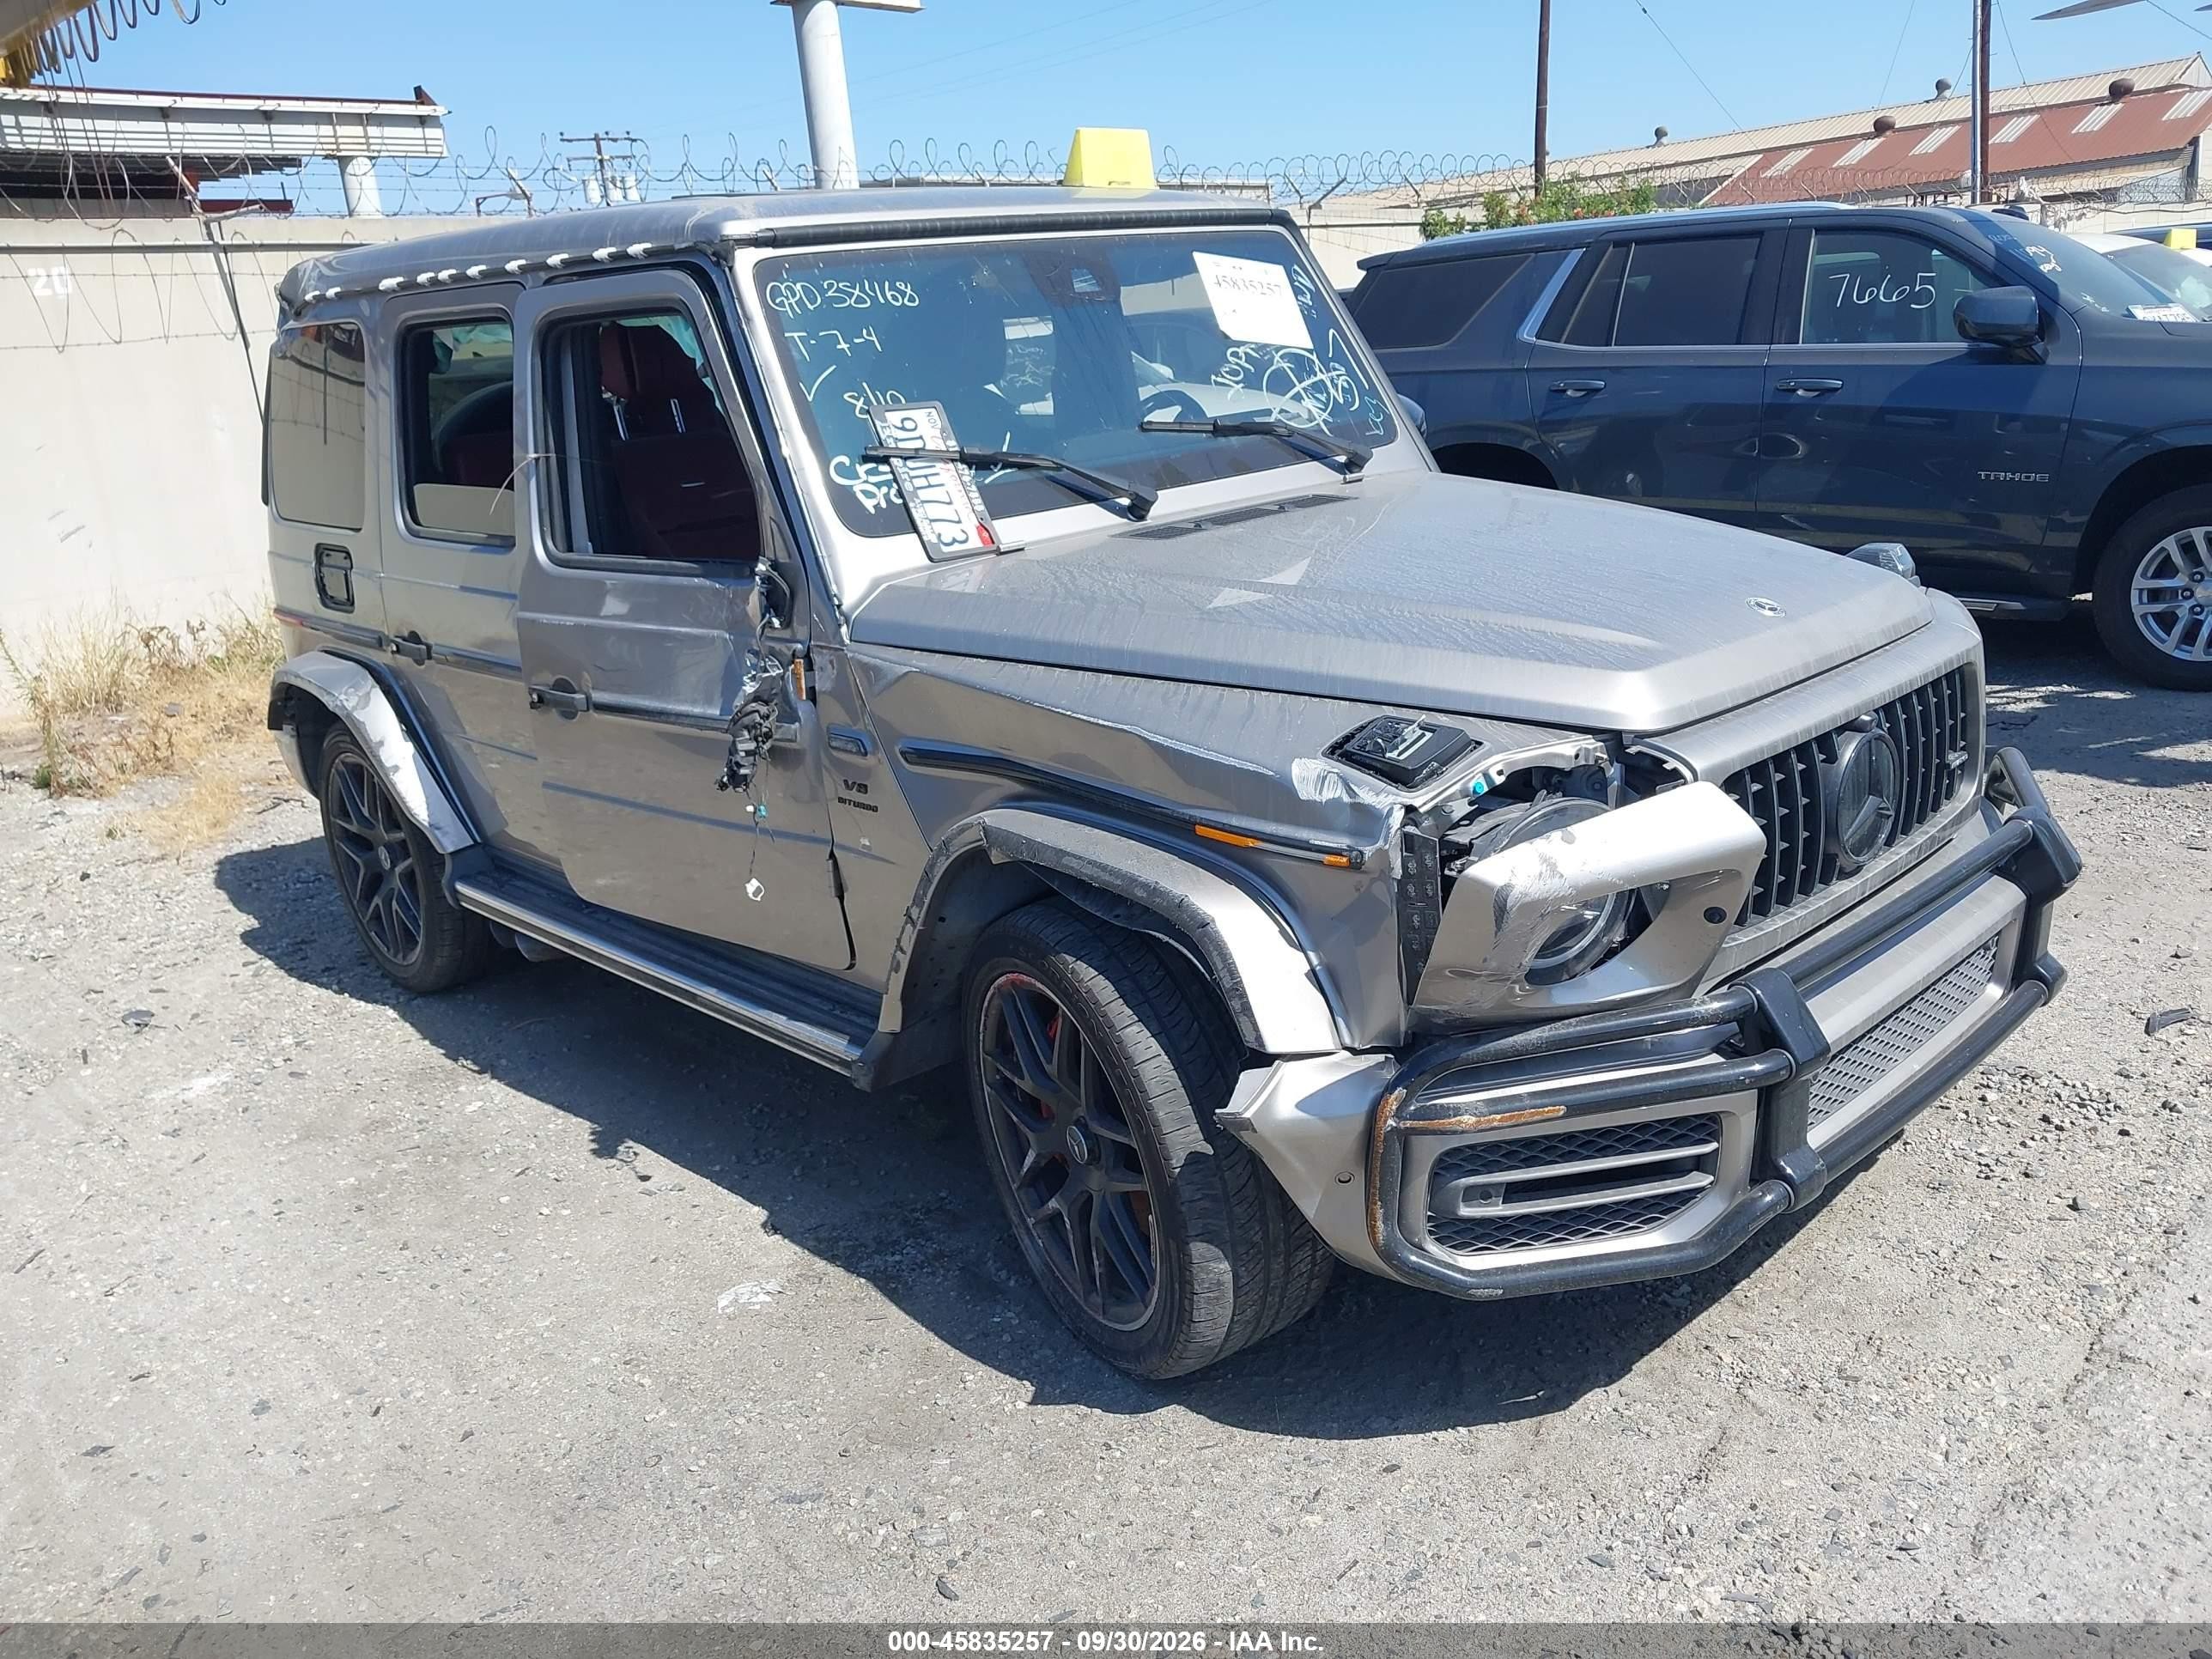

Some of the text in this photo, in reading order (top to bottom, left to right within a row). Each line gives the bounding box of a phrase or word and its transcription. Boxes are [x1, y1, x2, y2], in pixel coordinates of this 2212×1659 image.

[27, 265, 72, 296] 20
[1828, 272, 1937, 308] 7665
[766, 282, 822, 319] GPD
[924, 410, 941, 430] NOV
[1978, 471, 2049, 482] TAHOE
[842, 778, 869, 795] V8
[837, 796, 878, 813] BITURBO
